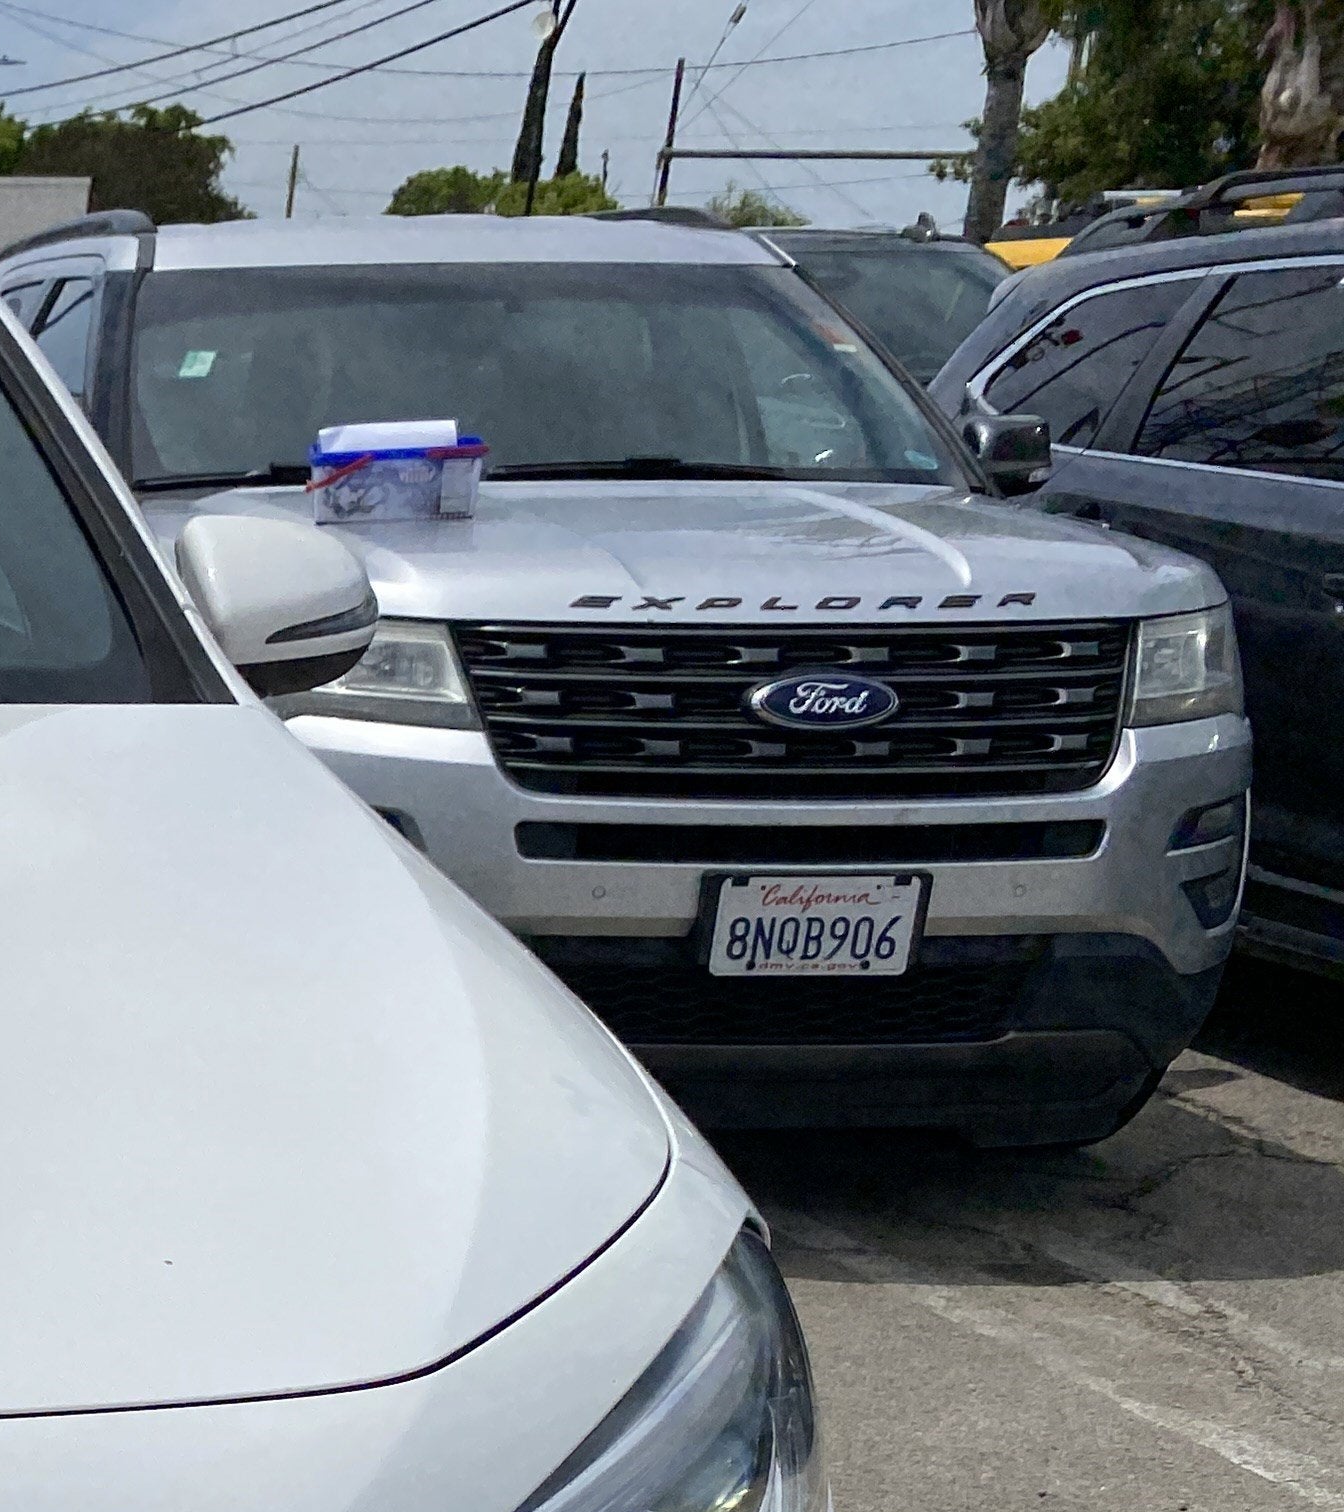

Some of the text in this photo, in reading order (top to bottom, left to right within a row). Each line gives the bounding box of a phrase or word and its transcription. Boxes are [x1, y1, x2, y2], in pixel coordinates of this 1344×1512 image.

[569, 592, 1036, 610] EXPLORER
[789, 682, 868, 715] Ford
[761, 884, 881, 913] California
[726, 915, 902, 961] 8NQB906
